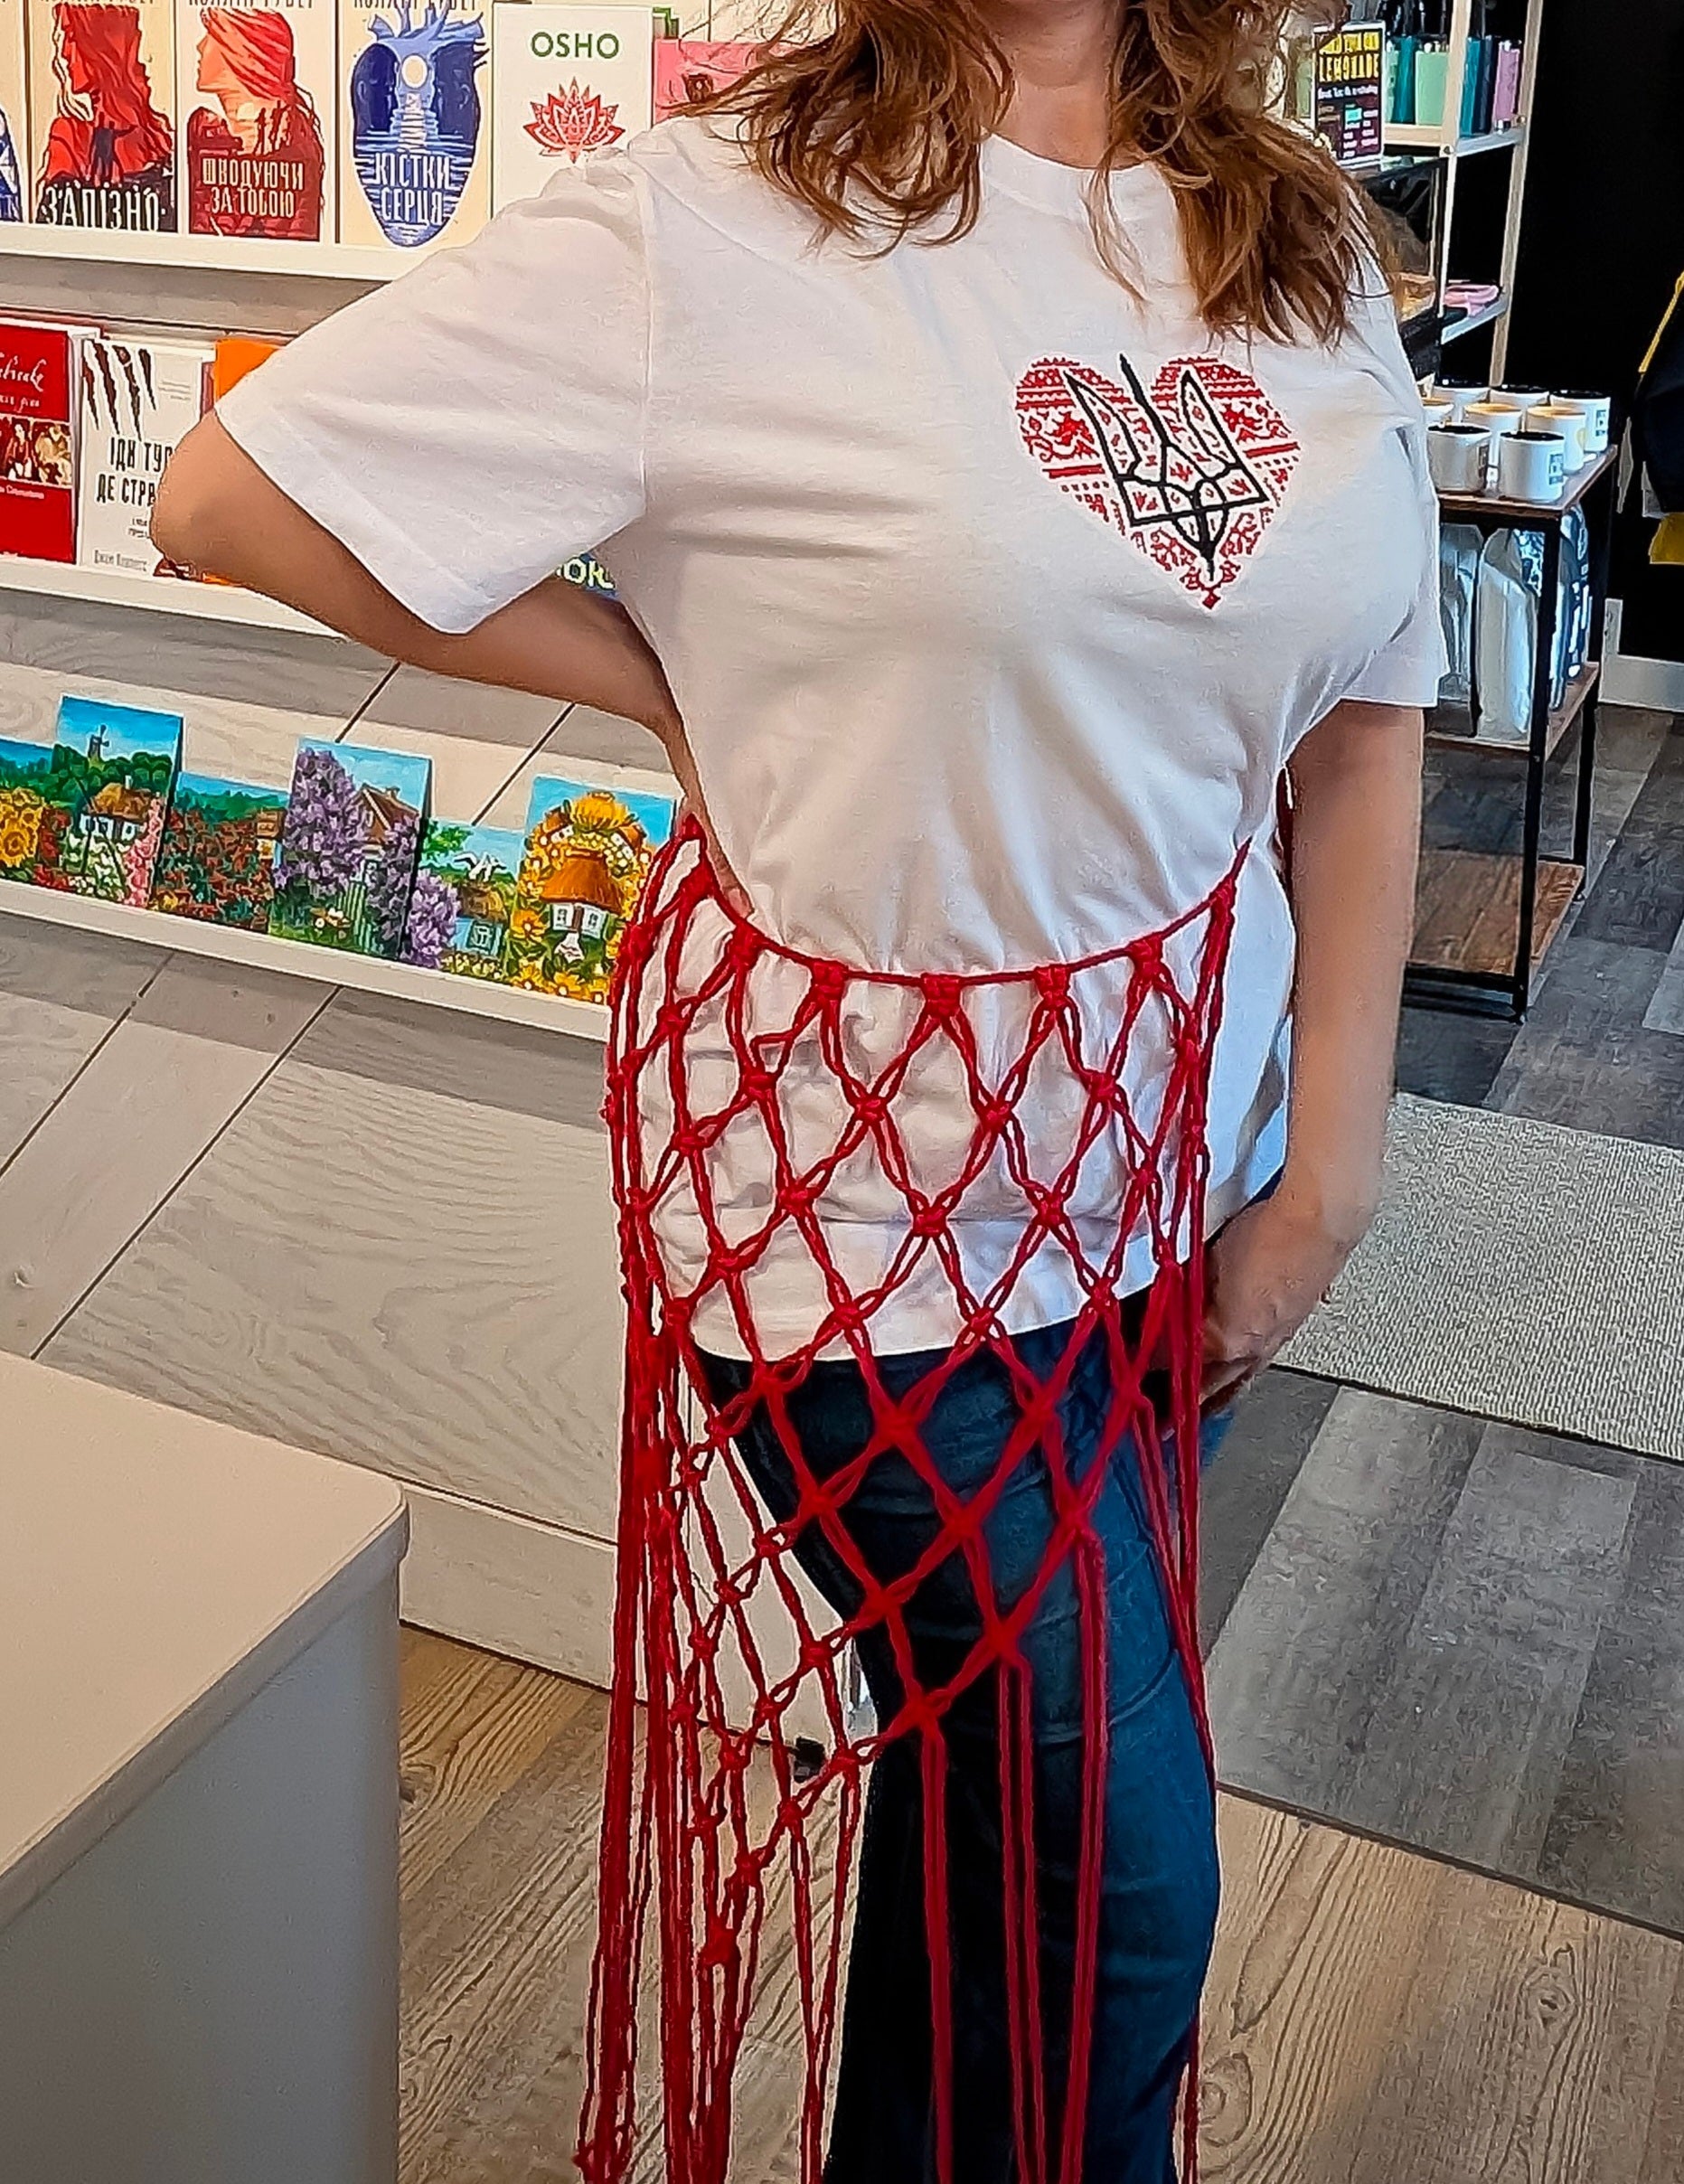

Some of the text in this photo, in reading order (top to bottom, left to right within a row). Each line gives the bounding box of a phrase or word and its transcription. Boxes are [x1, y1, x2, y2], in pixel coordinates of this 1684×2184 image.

[531, 32, 620, 60] OSHO
[375, 152, 451, 190] КІСТКИ
[45, 185, 159, 231] ЗАПІЗНО
[211, 186, 295, 218] ЗА ТОБОЮ
[381, 186, 443, 226] СЕРЦЯ
[97, 473, 156, 506] ДЕ СТРА
